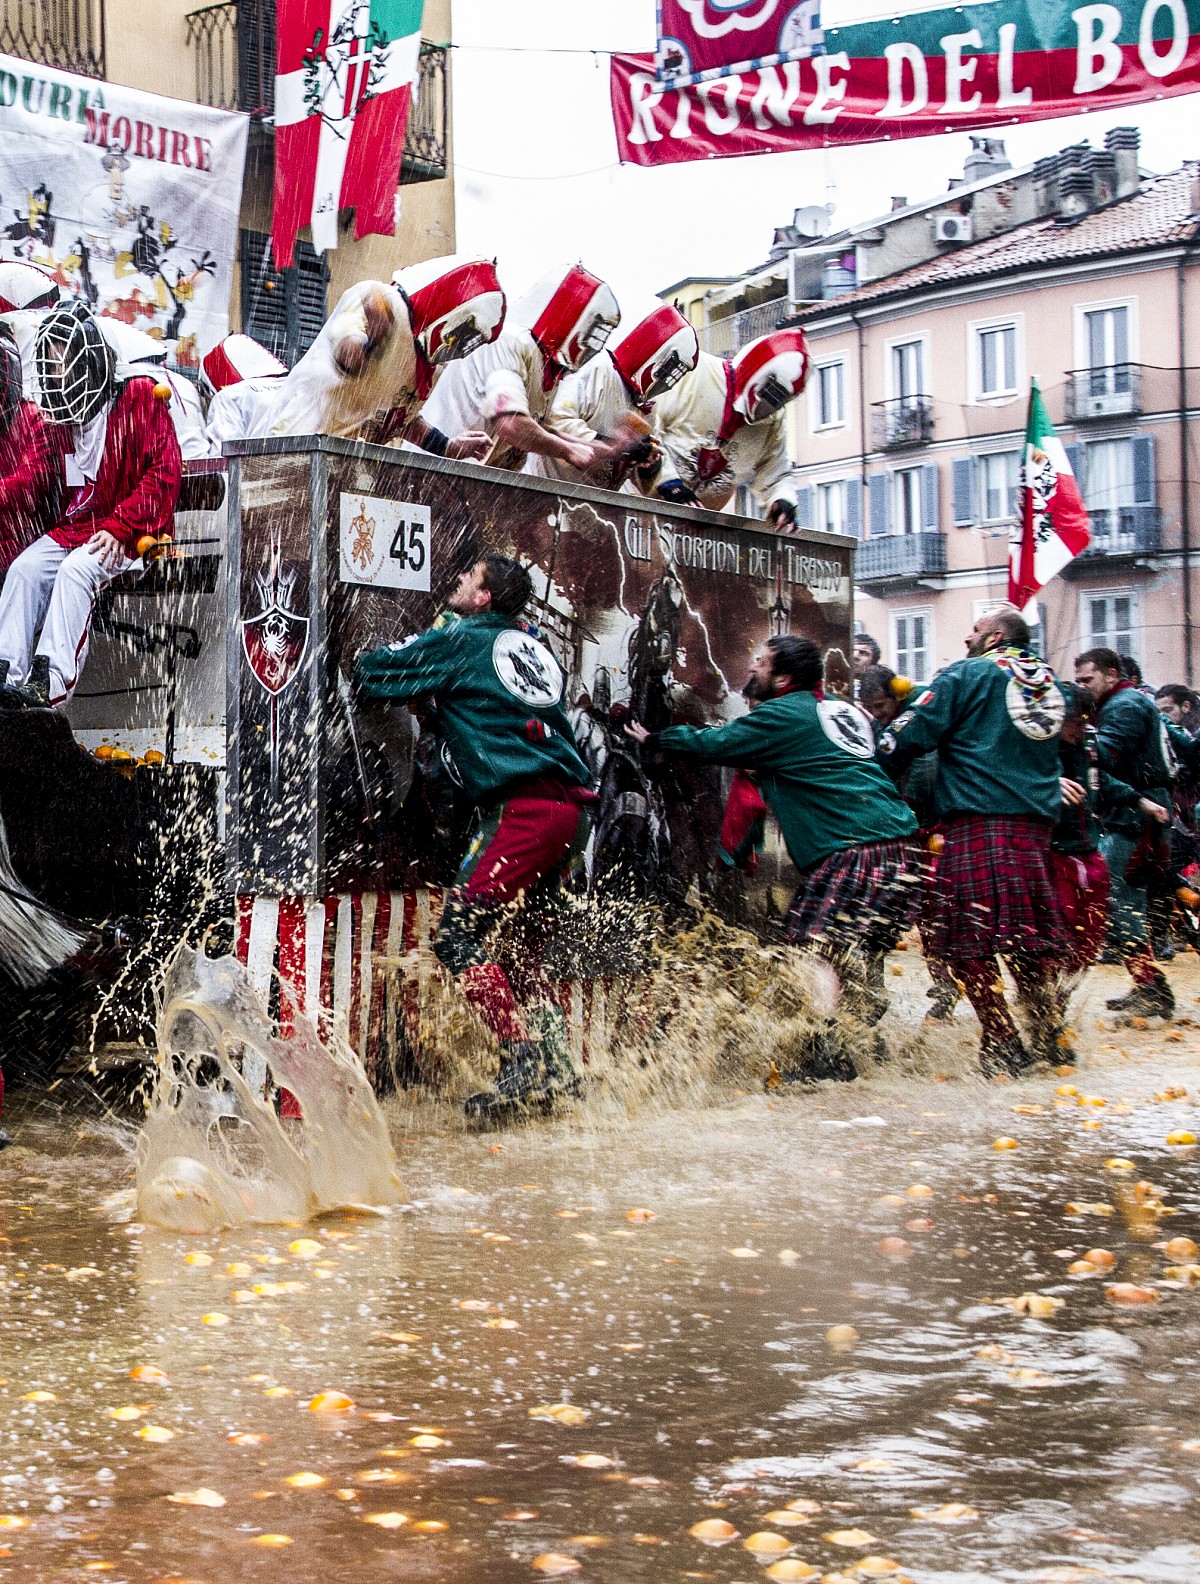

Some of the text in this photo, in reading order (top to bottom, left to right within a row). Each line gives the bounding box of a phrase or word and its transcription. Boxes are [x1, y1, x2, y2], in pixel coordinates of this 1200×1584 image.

[91, 87, 106, 110] A
[627, 0, 1190, 145] RIONE DEL BO
[83, 107, 214, 172] MORIRE
[389, 519, 426, 572] 45
